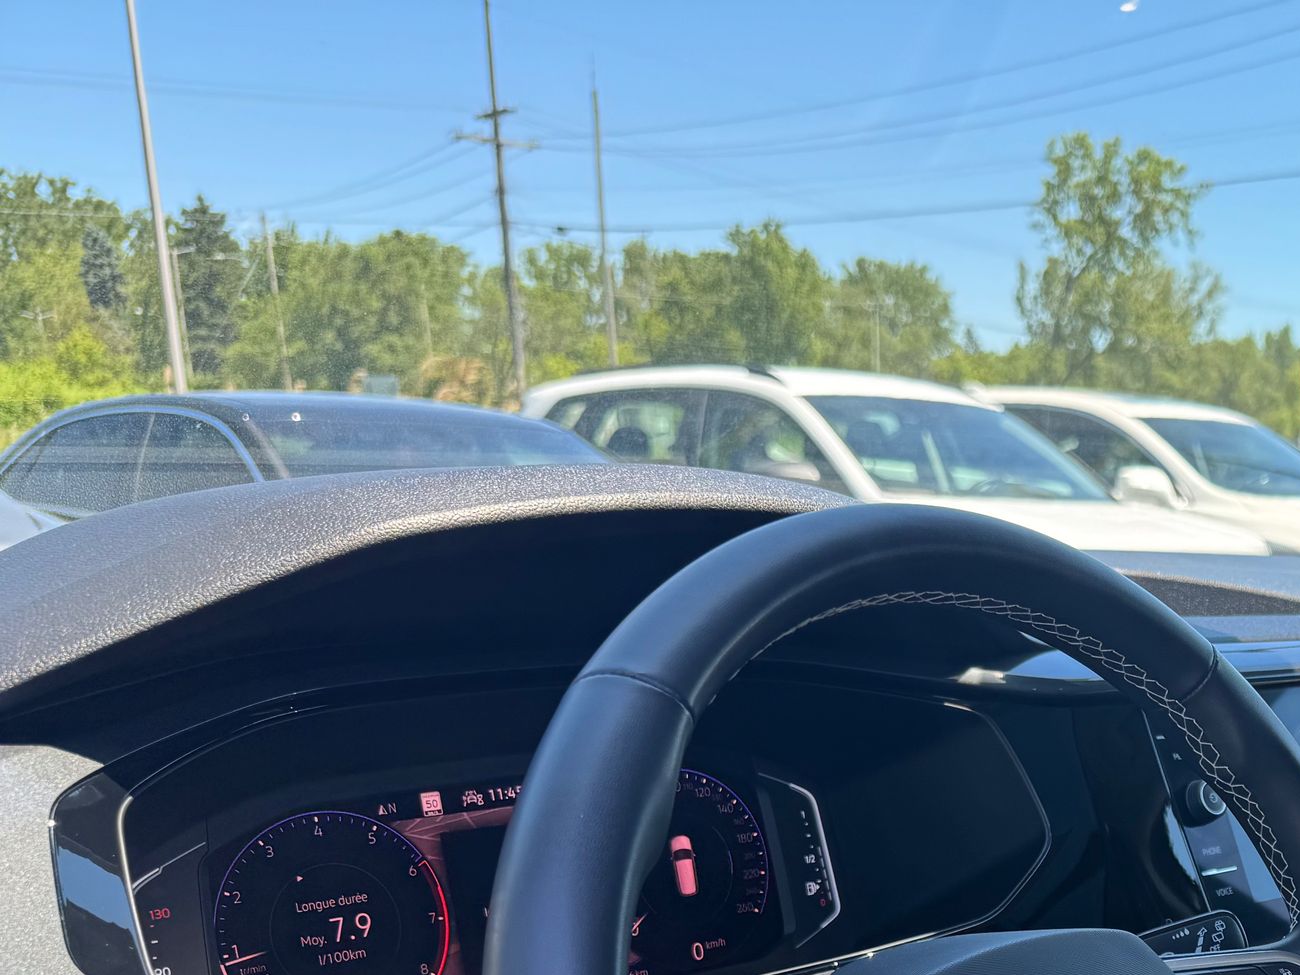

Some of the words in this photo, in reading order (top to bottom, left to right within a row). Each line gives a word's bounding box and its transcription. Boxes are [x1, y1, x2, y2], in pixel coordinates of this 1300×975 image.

[695, 787, 711, 798] 120
[388, 803, 397, 814] N
[425, 799, 439, 809] 50
[717, 803, 734, 814] 140
[313, 826, 323, 838] 4
[737, 832, 753, 843] 180
[368, 832, 377, 845] 5
[265, 845, 275, 859] 3
[1202, 845, 1222, 857] PHONE
[804, 854, 816, 864] 1/2
[408, 865, 417, 877] 6
[743, 868, 760, 880] 220
[1215, 886, 1234, 897] VOICE
[233, 892, 242, 904] 2
[295, 899, 336, 913] Longue
[338, 892, 368, 906] durée
[148, 908, 171, 921] 130
[736, 903, 754, 914] 260
[428, 913, 436, 924] 7
[300, 935, 328, 948] Moy.
[328, 912, 372, 943] 7.9
[231, 944, 240, 959] 1
[692, 942, 704, 960] 0
[705, 938, 726, 949] km/h
[318, 948, 367, 967] l/100km
[239, 964, 267, 975] tr/min
[420, 963, 429, 975] 8
